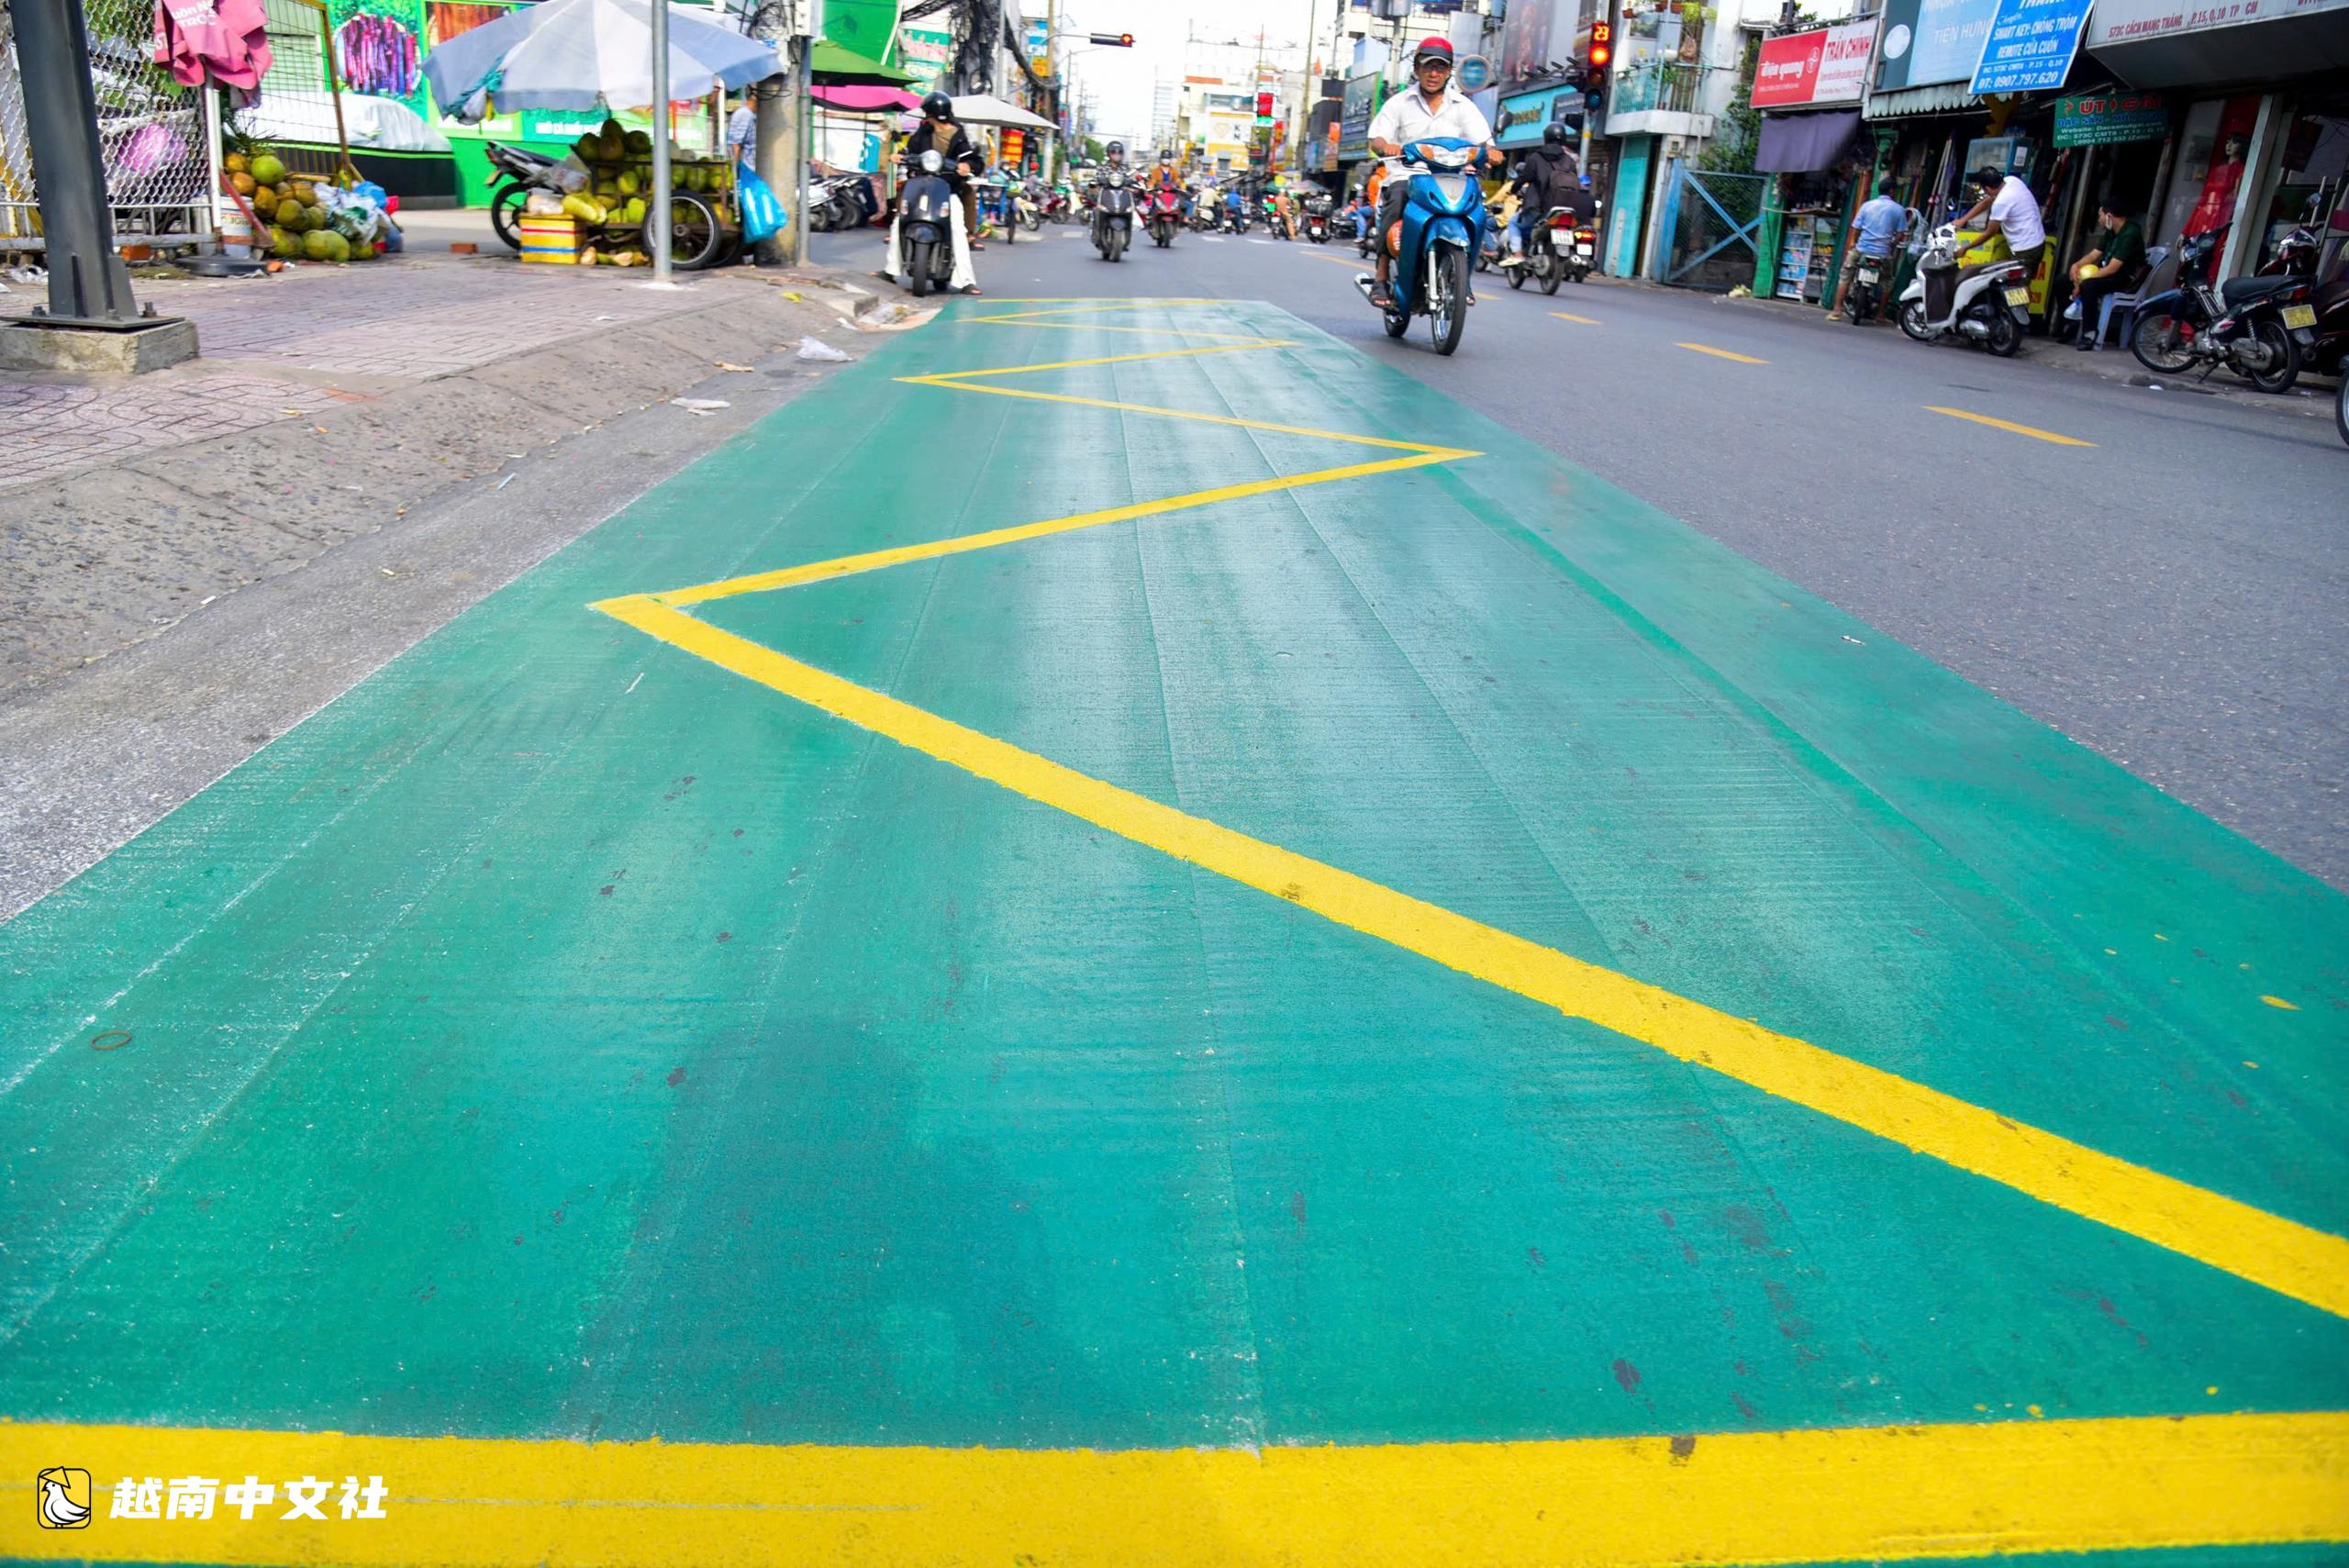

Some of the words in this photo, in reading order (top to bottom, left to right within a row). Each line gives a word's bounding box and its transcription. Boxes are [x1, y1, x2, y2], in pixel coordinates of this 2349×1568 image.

[1594, 26, 1609, 40] 23
[1994, 26, 2017, 40] SMART
[1998, 43, 2022, 58] REMOTE
[1994, 71, 2059, 88] 0907.797.620
